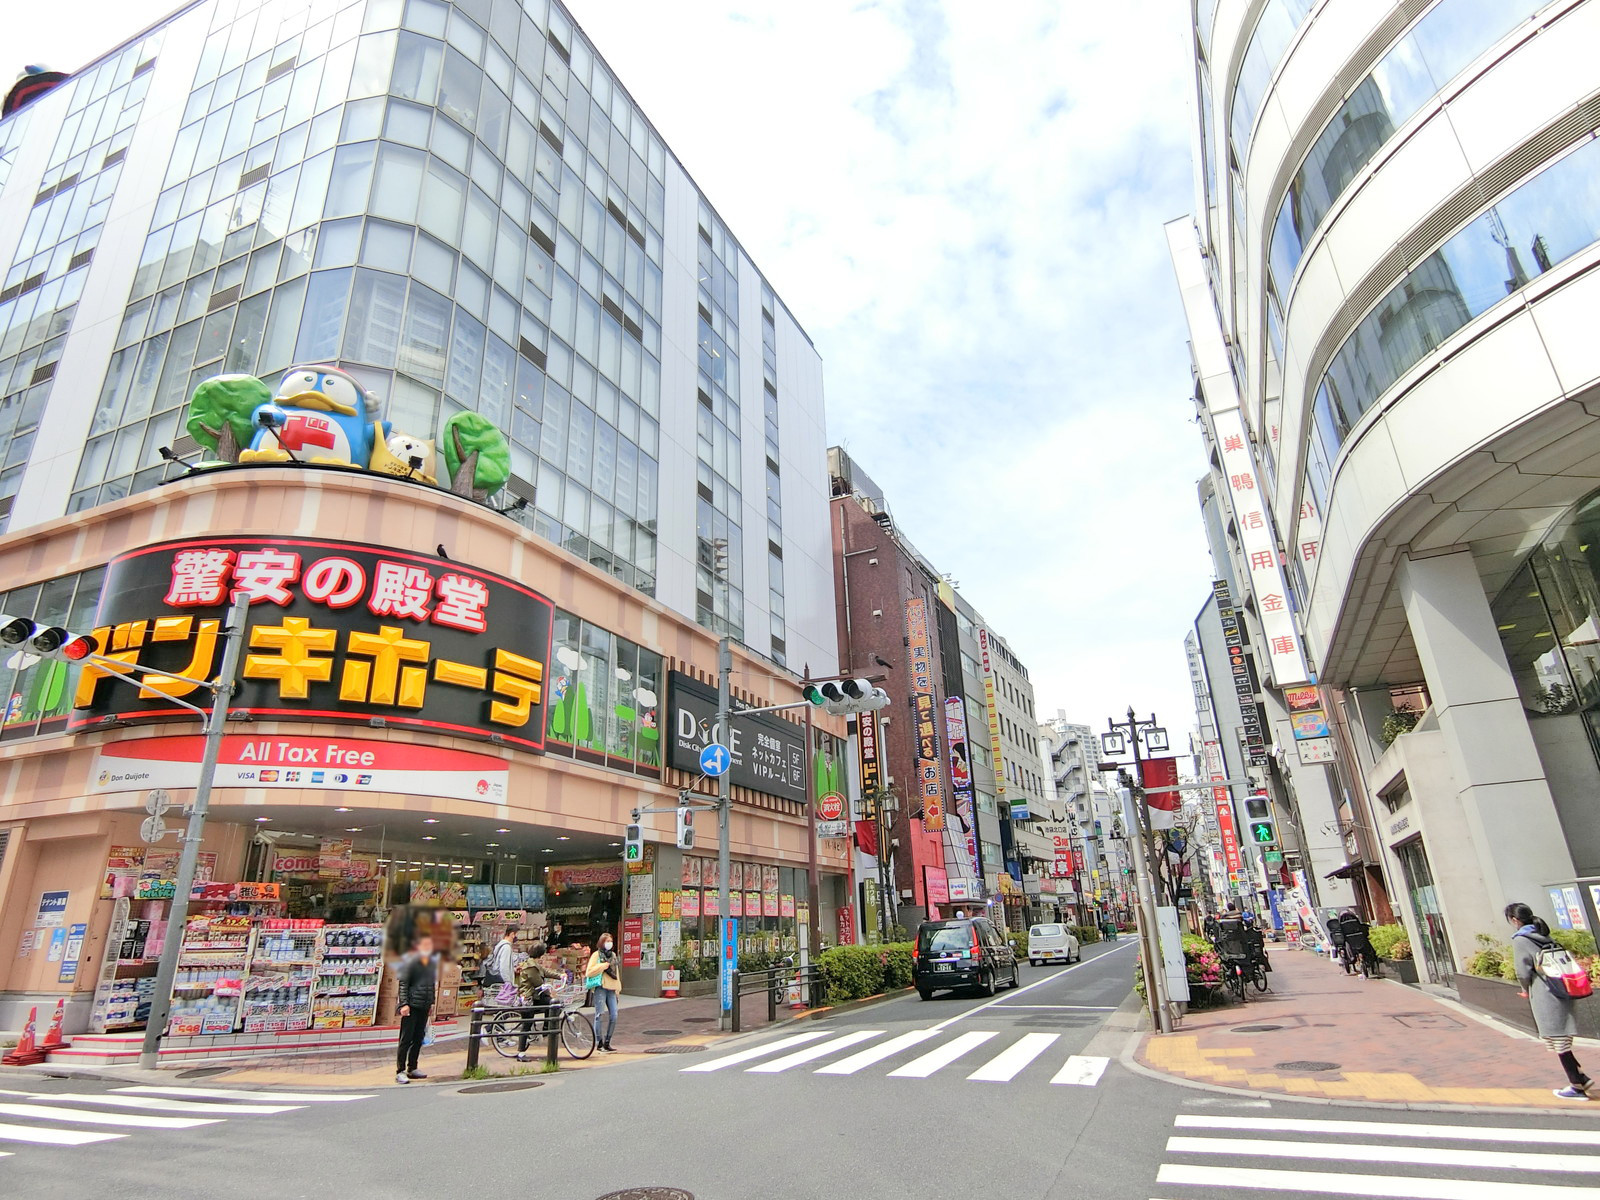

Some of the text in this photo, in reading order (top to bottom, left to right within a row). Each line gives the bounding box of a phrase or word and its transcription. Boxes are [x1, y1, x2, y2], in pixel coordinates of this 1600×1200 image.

[1223, 434, 1296, 655] 巣鴨信用金庫
[164, 548, 489, 633] 驚安の殿堂
[913, 646, 929, 688] 実物を
[1288, 691, 1316, 703] Milky
[917, 695, 934, 757] 見て選べる
[757, 733, 781, 752] 完全個室
[239, 742, 375, 766] All Tax Free
[752, 747, 787, 769] ネットカフェ
[792, 752, 800, 764] 5F
[111, 772, 150, 782] Don Quijote
[237, 772, 255, 780] VISA
[752, 762, 787, 783] VIPルーム
[923, 766, 938, 796] お店
[273, 852, 320, 872] come
